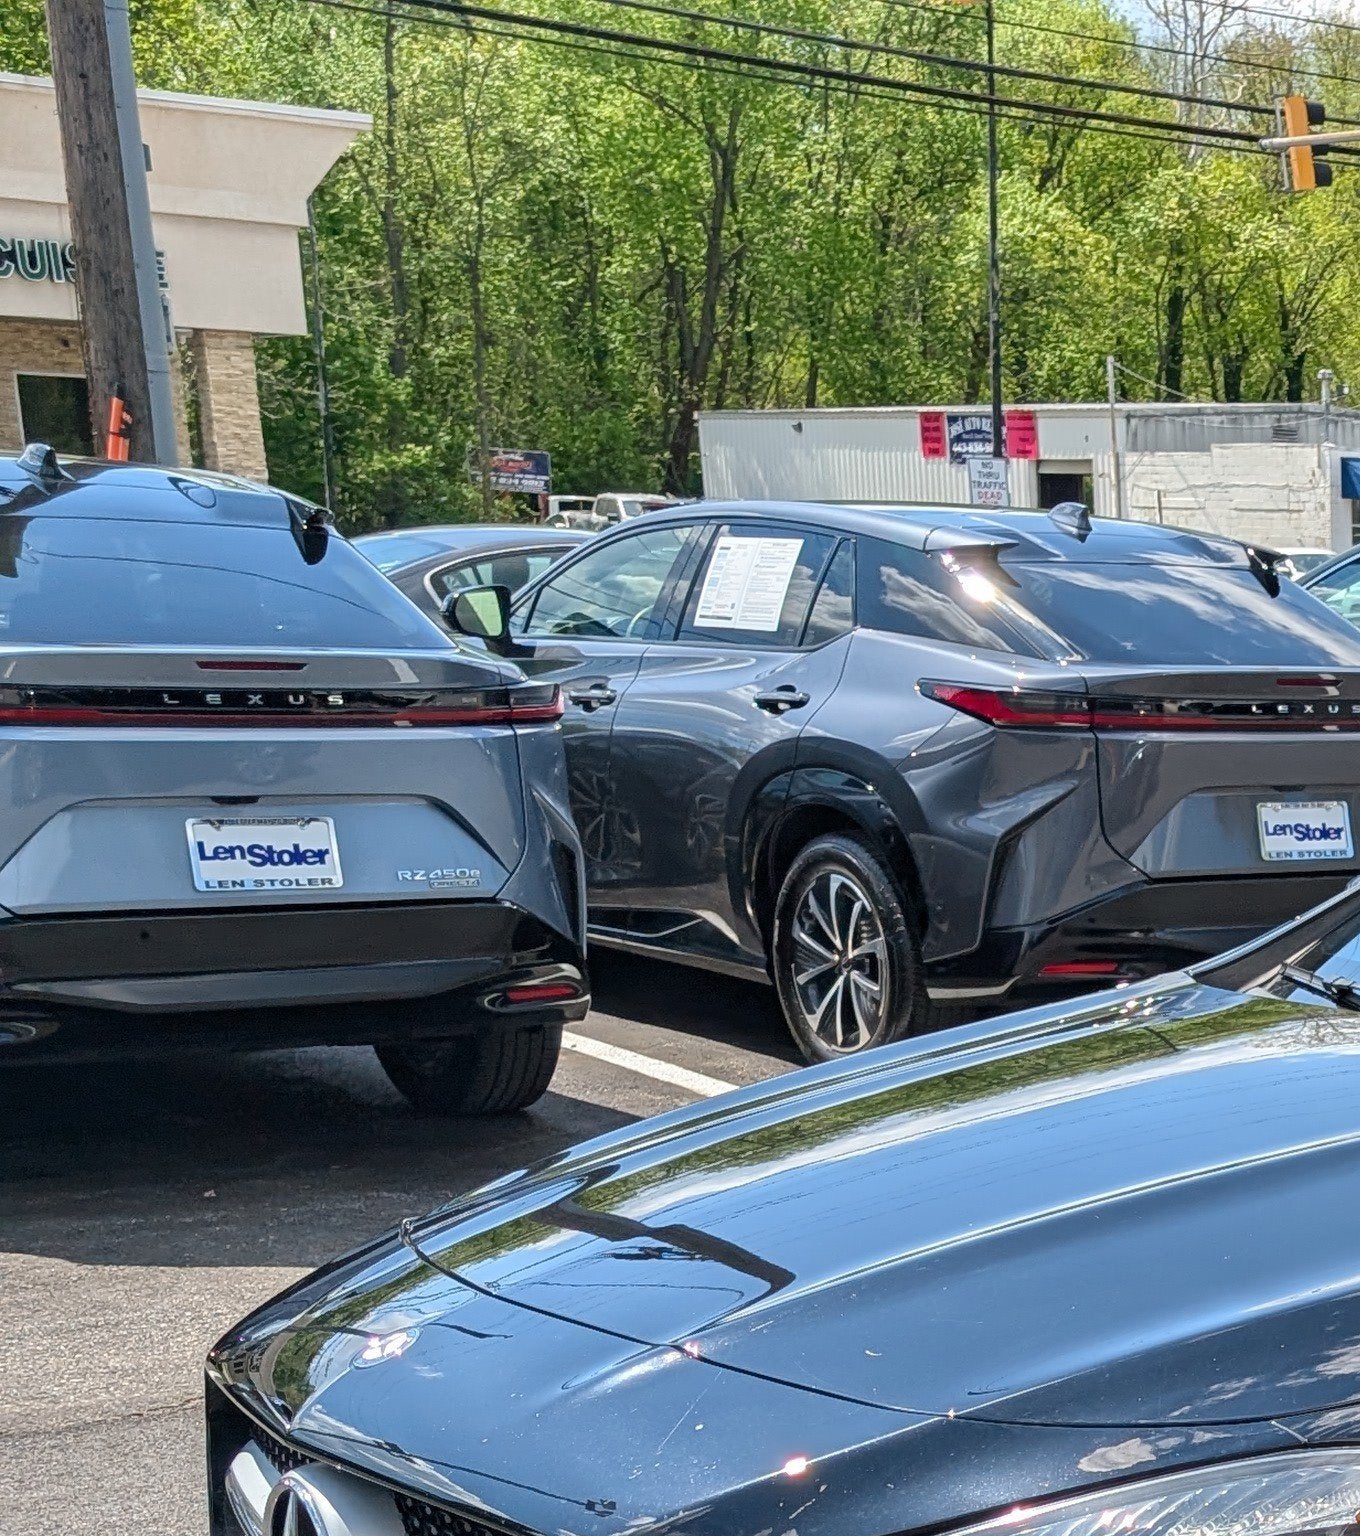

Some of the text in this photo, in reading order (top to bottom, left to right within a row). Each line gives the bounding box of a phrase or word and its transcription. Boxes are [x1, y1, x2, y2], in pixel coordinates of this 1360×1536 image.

[981, 462, 993, 470] NO
[977, 471, 1000, 480] THRU
[971, 481, 1006, 491] TRAFFIC
[977, 490, 1003, 501] DEAD
[162, 693, 344, 705] LEXUS
[1268, 849, 1348, 859] LEN STOLER
[204, 877, 335, 890] LEN STOLER
